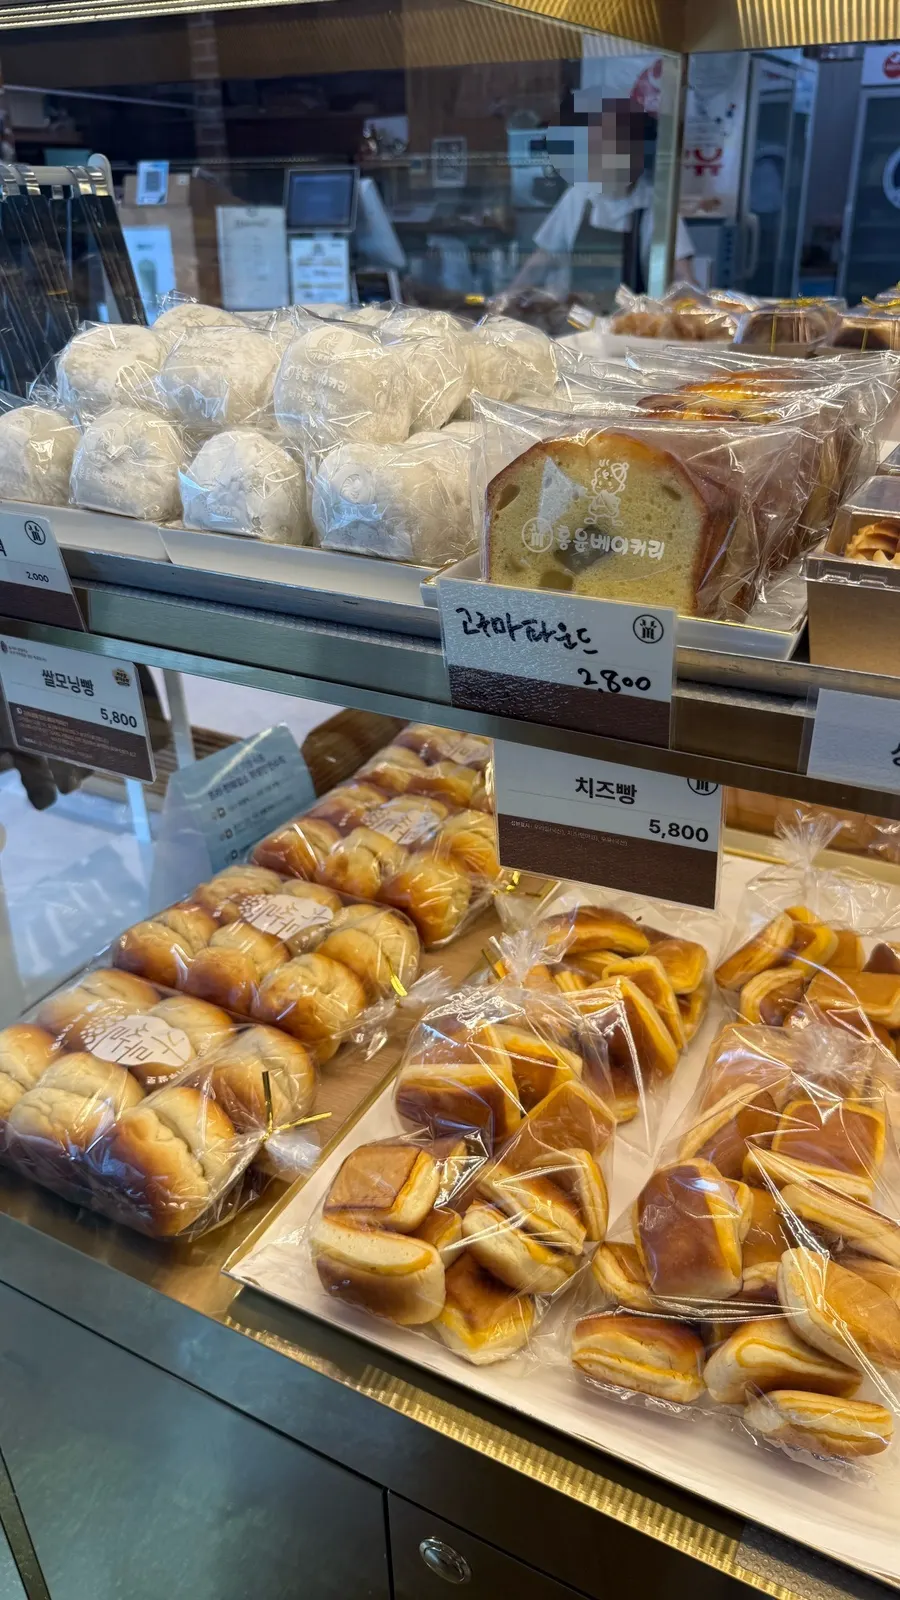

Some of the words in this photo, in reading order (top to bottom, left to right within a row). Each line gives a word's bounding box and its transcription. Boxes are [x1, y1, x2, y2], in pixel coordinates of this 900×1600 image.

[557, 525, 665, 560] 홍윤베이커리
[42, 668, 95, 697] 쌀모닝빵
[100, 708, 138, 728] 5,800
[575, 777, 637, 805] 치즈빵
[649, 819, 709, 843] 5,800
